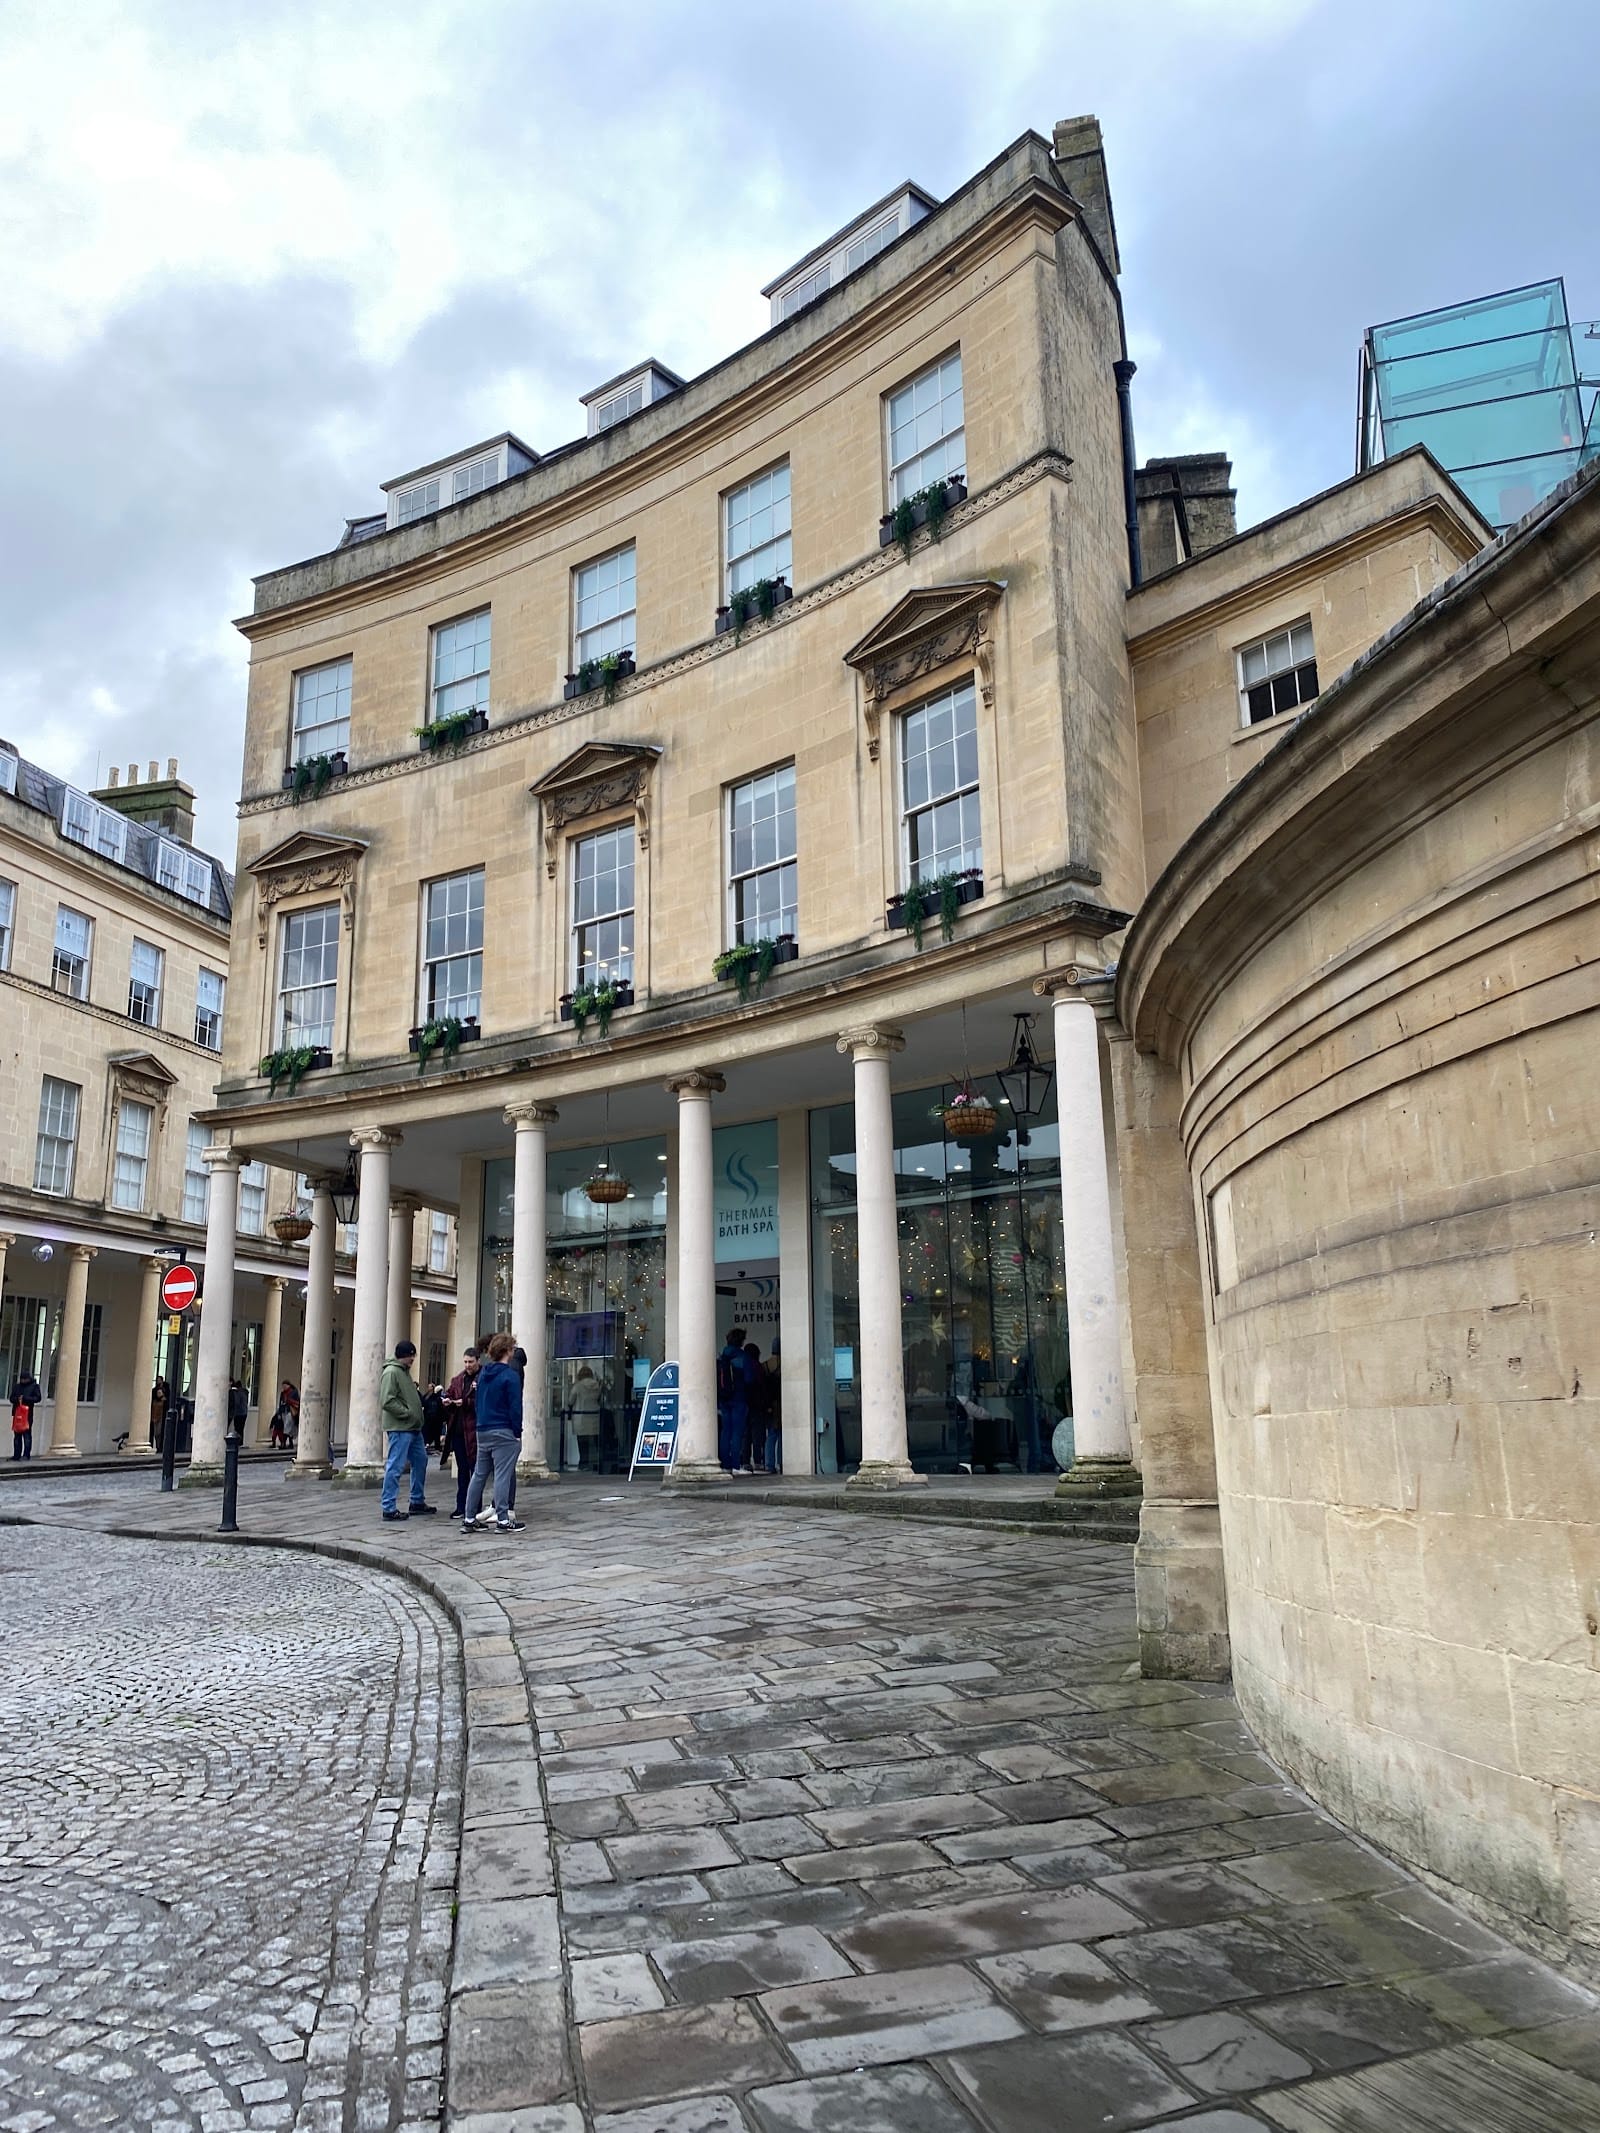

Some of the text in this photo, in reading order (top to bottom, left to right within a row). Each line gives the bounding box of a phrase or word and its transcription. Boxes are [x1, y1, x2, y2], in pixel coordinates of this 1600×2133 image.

[719, 1205, 774, 1222] THERMAE
[719, 1221, 774, 1238] BATH SPA
[734, 1313, 764, 1323] BATH
